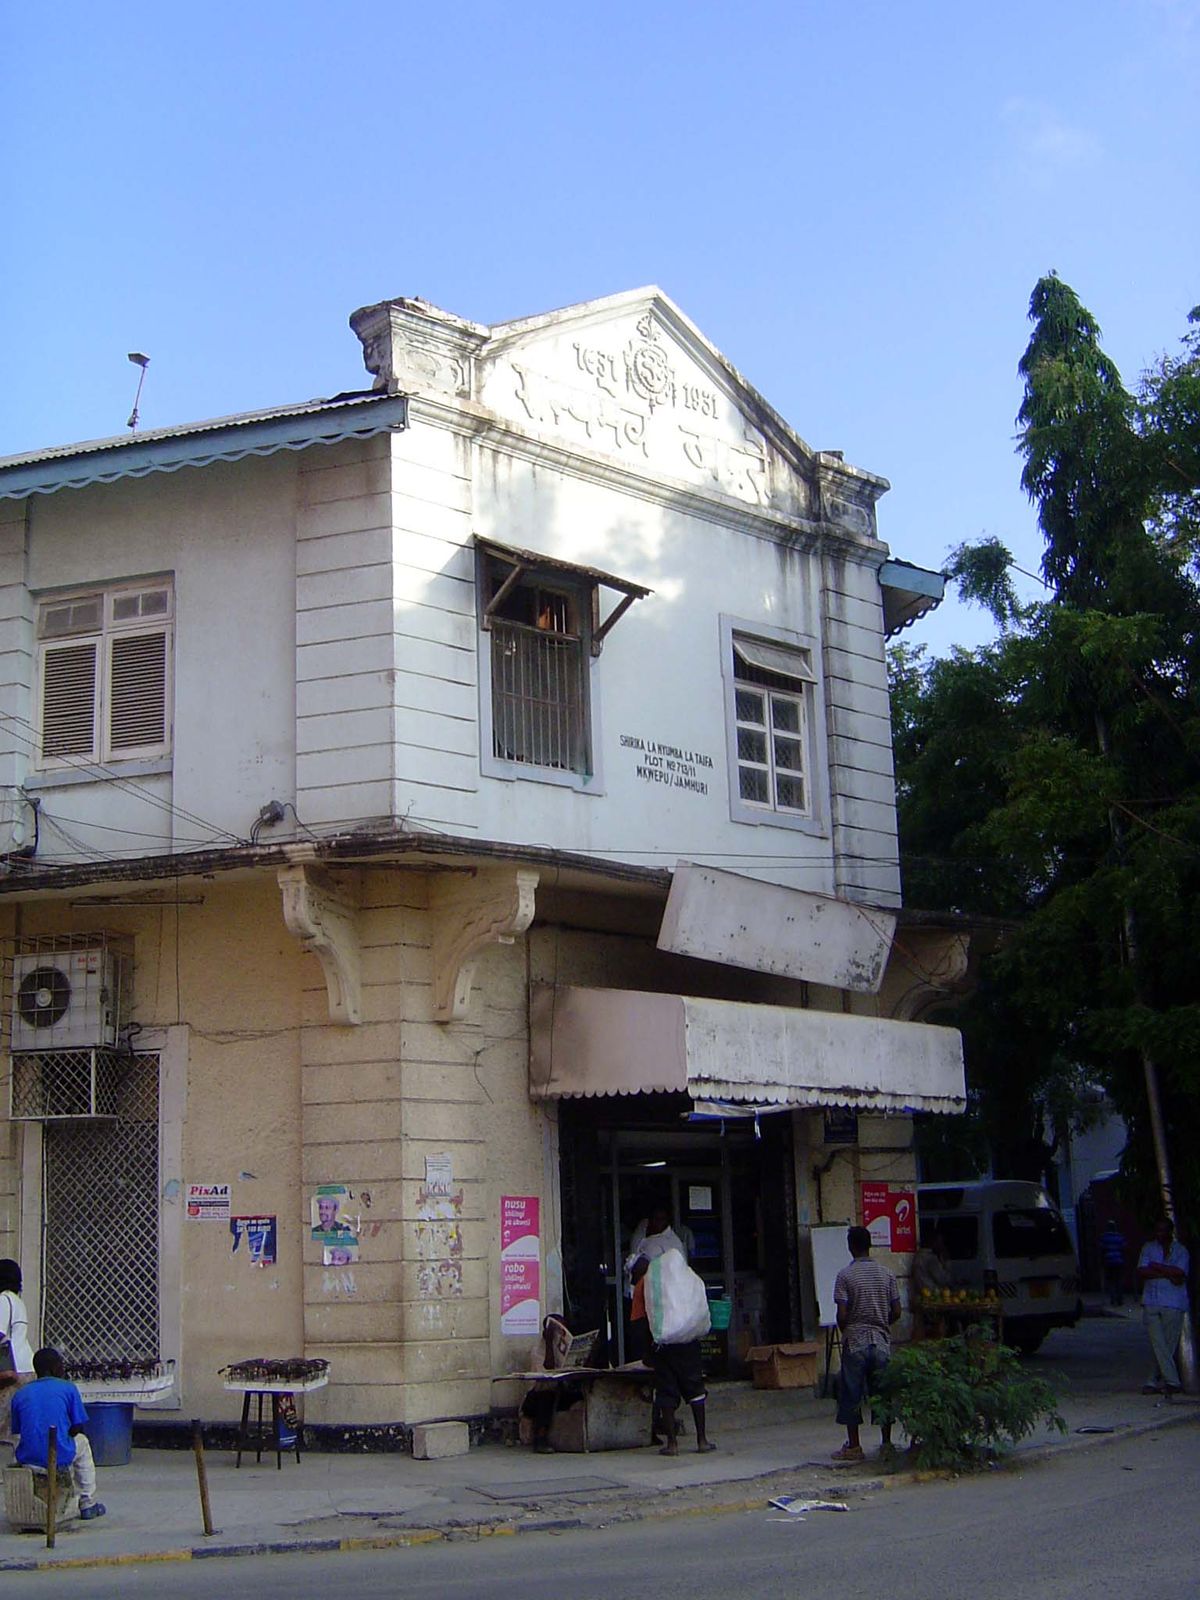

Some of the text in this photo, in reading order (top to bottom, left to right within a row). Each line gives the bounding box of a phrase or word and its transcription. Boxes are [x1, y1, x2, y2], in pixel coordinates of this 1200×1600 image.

[619, 734, 713, 769] SHIRIKA LA NYUMBA LA TAIFA
[644, 753, 663, 767] PLOT
[190, 1185, 228, 1195] PixAd
[504, 1199, 526, 1210] nusu
[504, 1262, 525, 1273] robo
